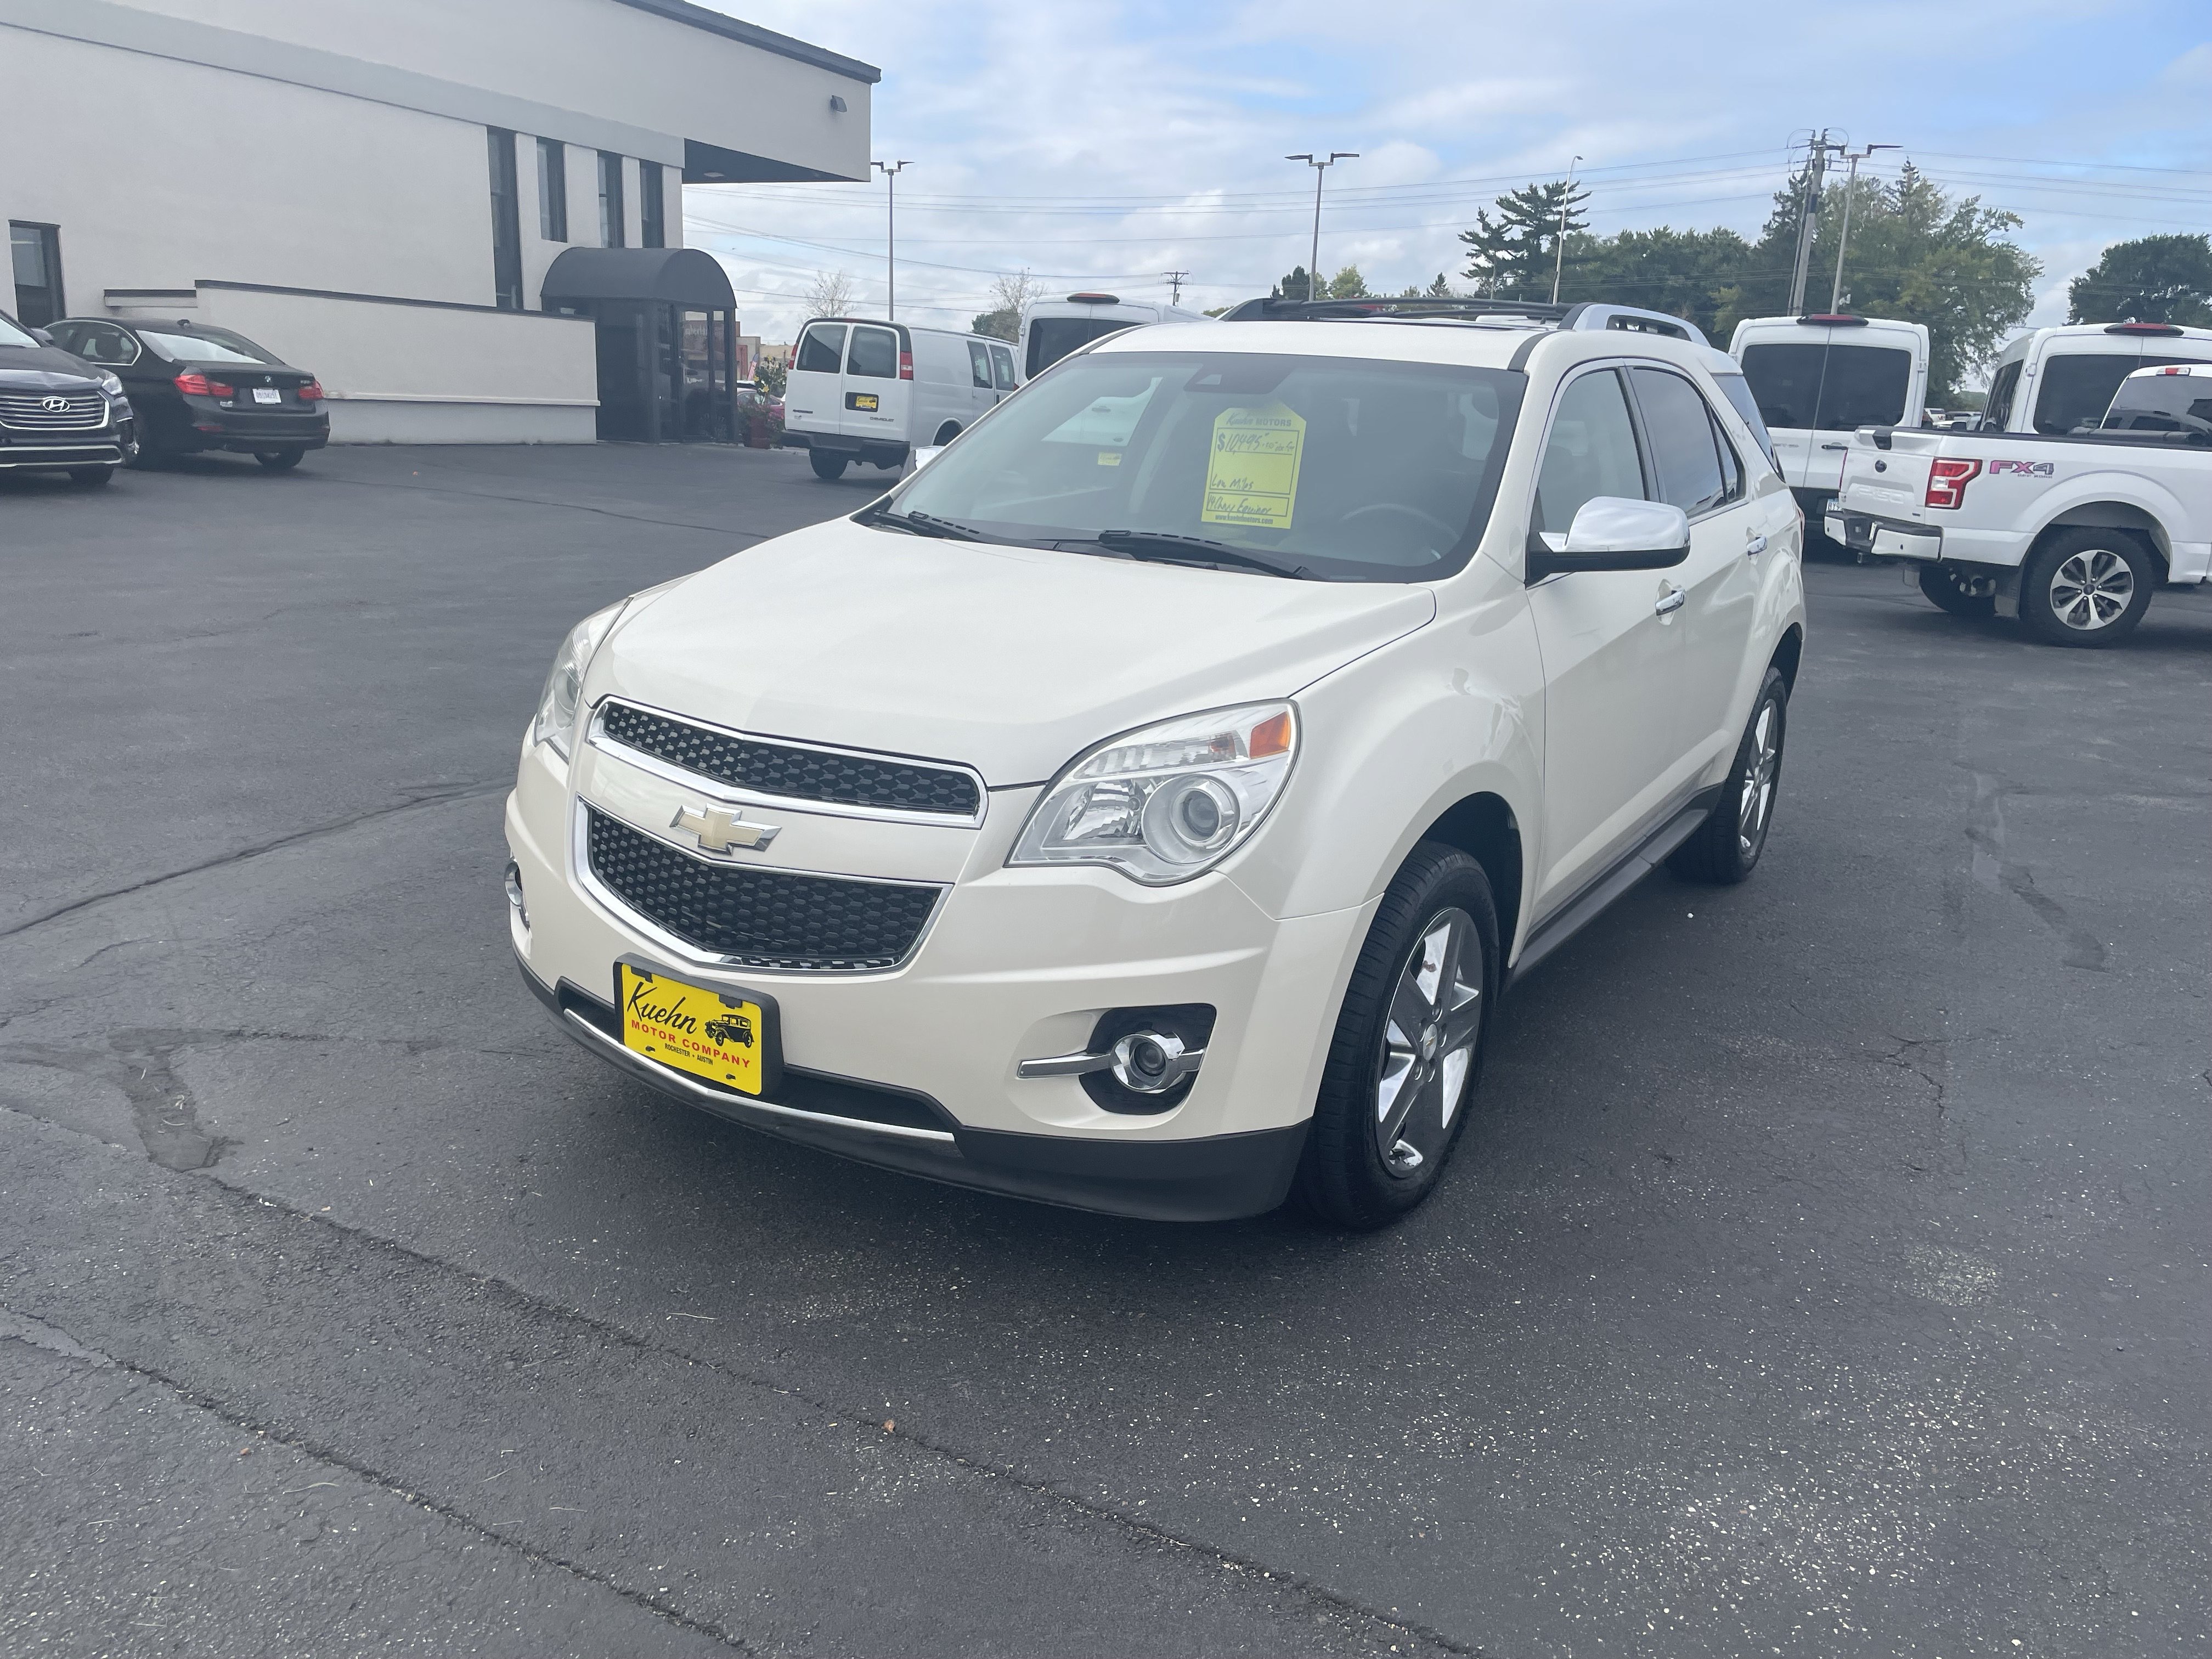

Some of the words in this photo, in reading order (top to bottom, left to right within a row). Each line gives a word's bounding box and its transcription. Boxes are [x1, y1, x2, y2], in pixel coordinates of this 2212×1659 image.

[1256, 418, 1292, 427] MOTORS
[1989, 460, 2054, 475] FX4
[627, 981, 697, 1035] Kuehn
[631, 1019, 676, 1043] MOTOR
[682, 1038, 751, 1068] COMPANY
[664, 1043, 691, 1057] ROCHESTER
[697, 1054, 713, 1065] AUSTIN
